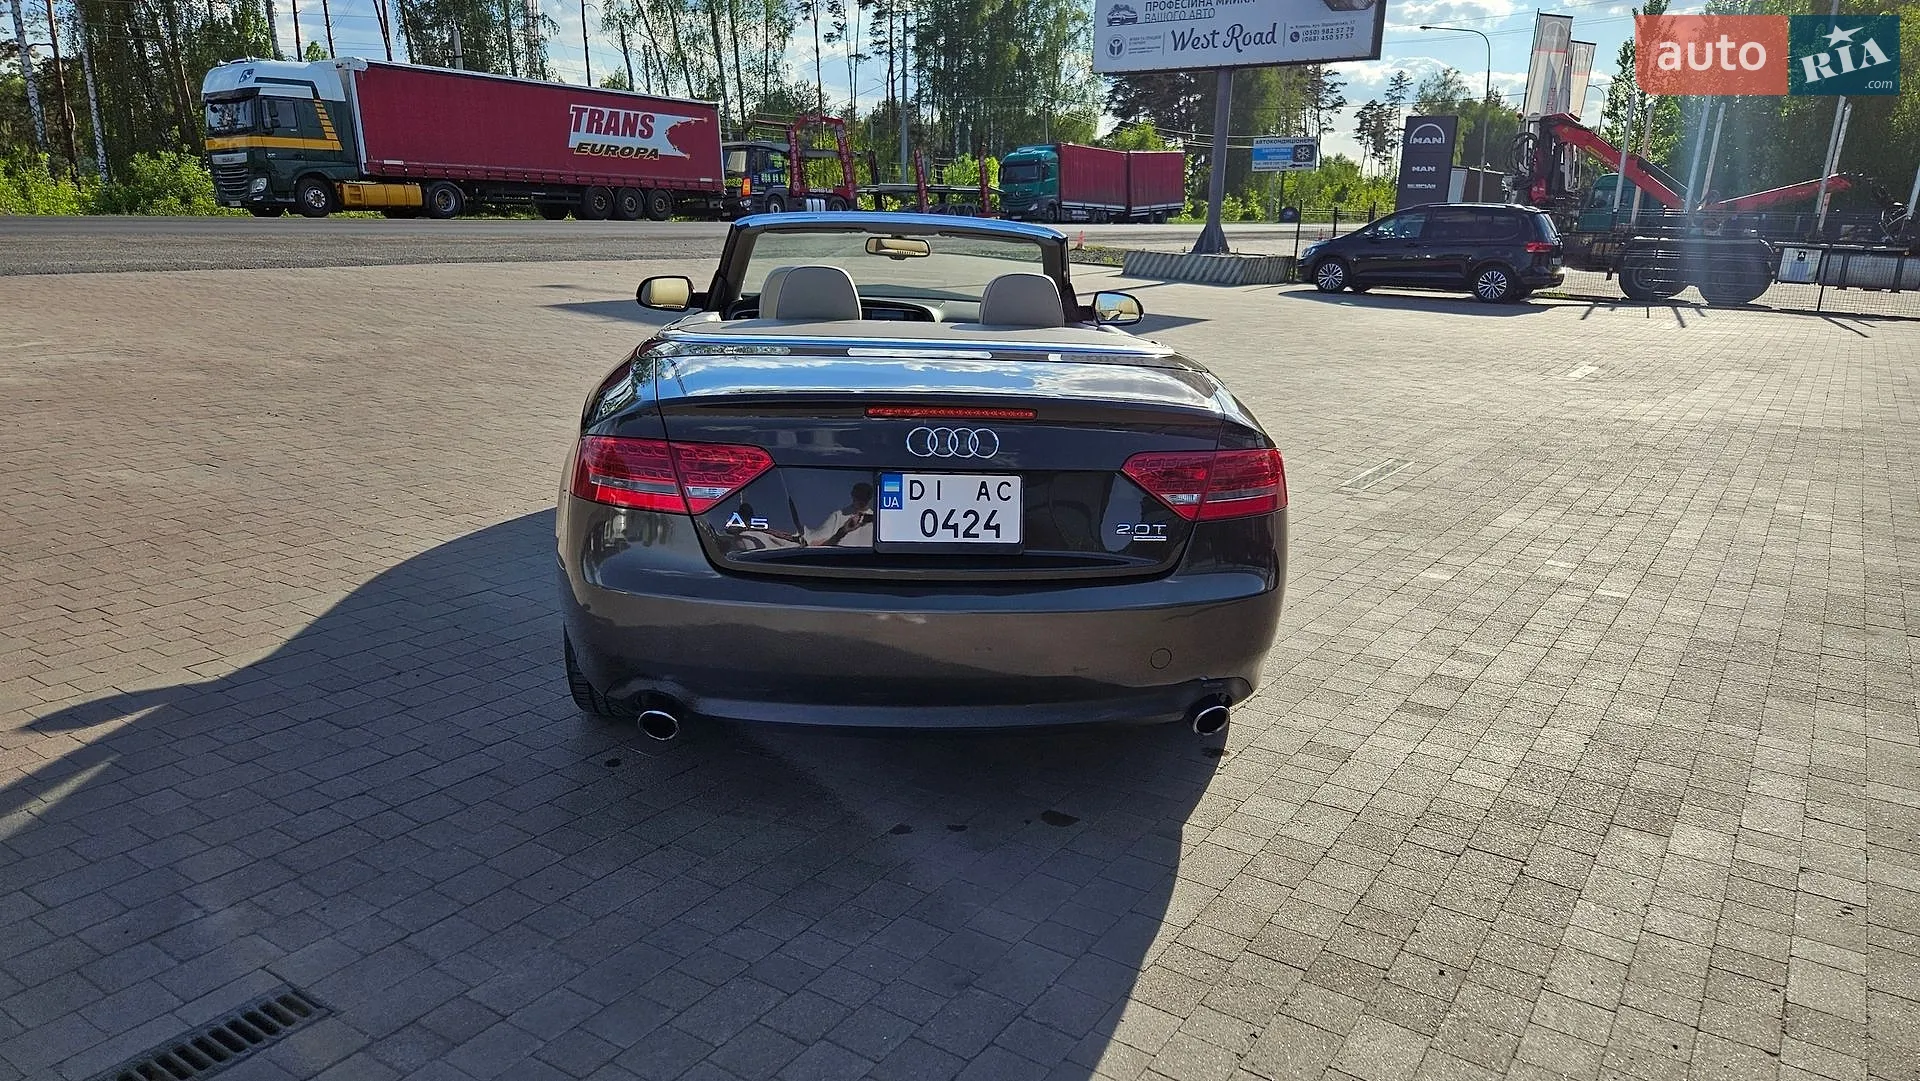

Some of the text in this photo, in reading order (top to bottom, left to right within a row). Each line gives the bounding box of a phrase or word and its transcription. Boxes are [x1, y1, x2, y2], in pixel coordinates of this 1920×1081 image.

[1144, 8, 1216, 23] ВАШОГО АВТО
[1170, 23, 1278, 53] West Road
[570, 105, 655, 140] TRANS
[574, 142, 660, 161] EUROPA
[909, 480, 1012, 502] DI AC
[883, 497, 900, 508] UA
[724, 511, 769, 530] A5
[920, 508, 1001, 539] 0424
[1116, 524, 1167, 535] 2.0T
